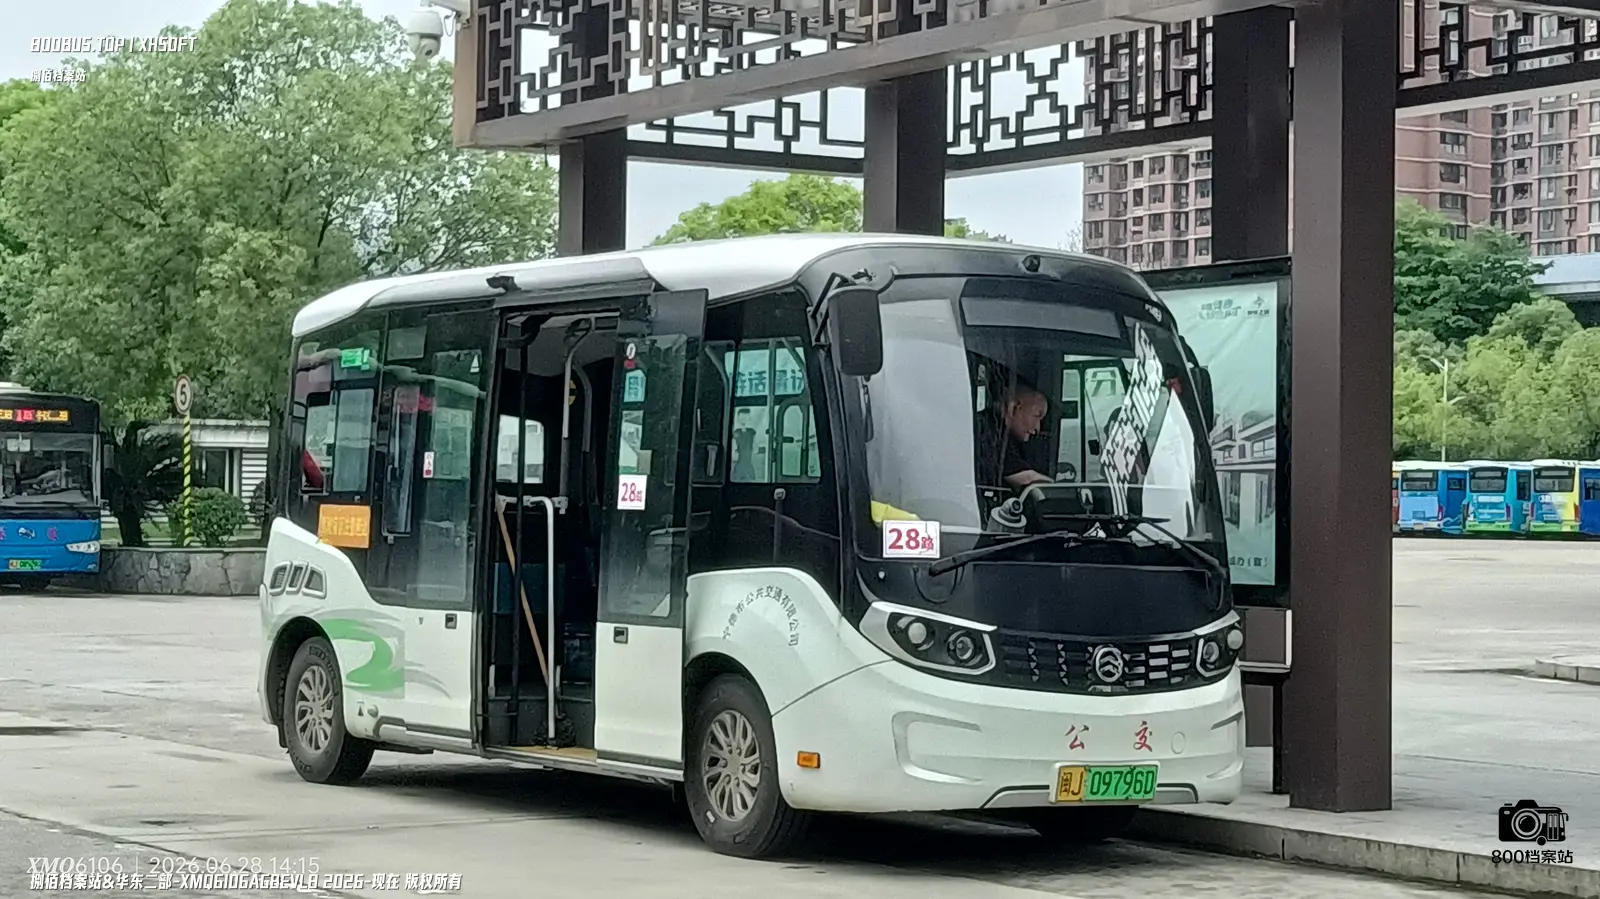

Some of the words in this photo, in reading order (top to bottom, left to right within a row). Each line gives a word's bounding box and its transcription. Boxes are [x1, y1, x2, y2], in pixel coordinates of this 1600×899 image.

[180, 383, 187, 406] 5
[888, 527, 935, 551] 28路
[722, 585, 799, 647] 宁德市公共交通有限公司
